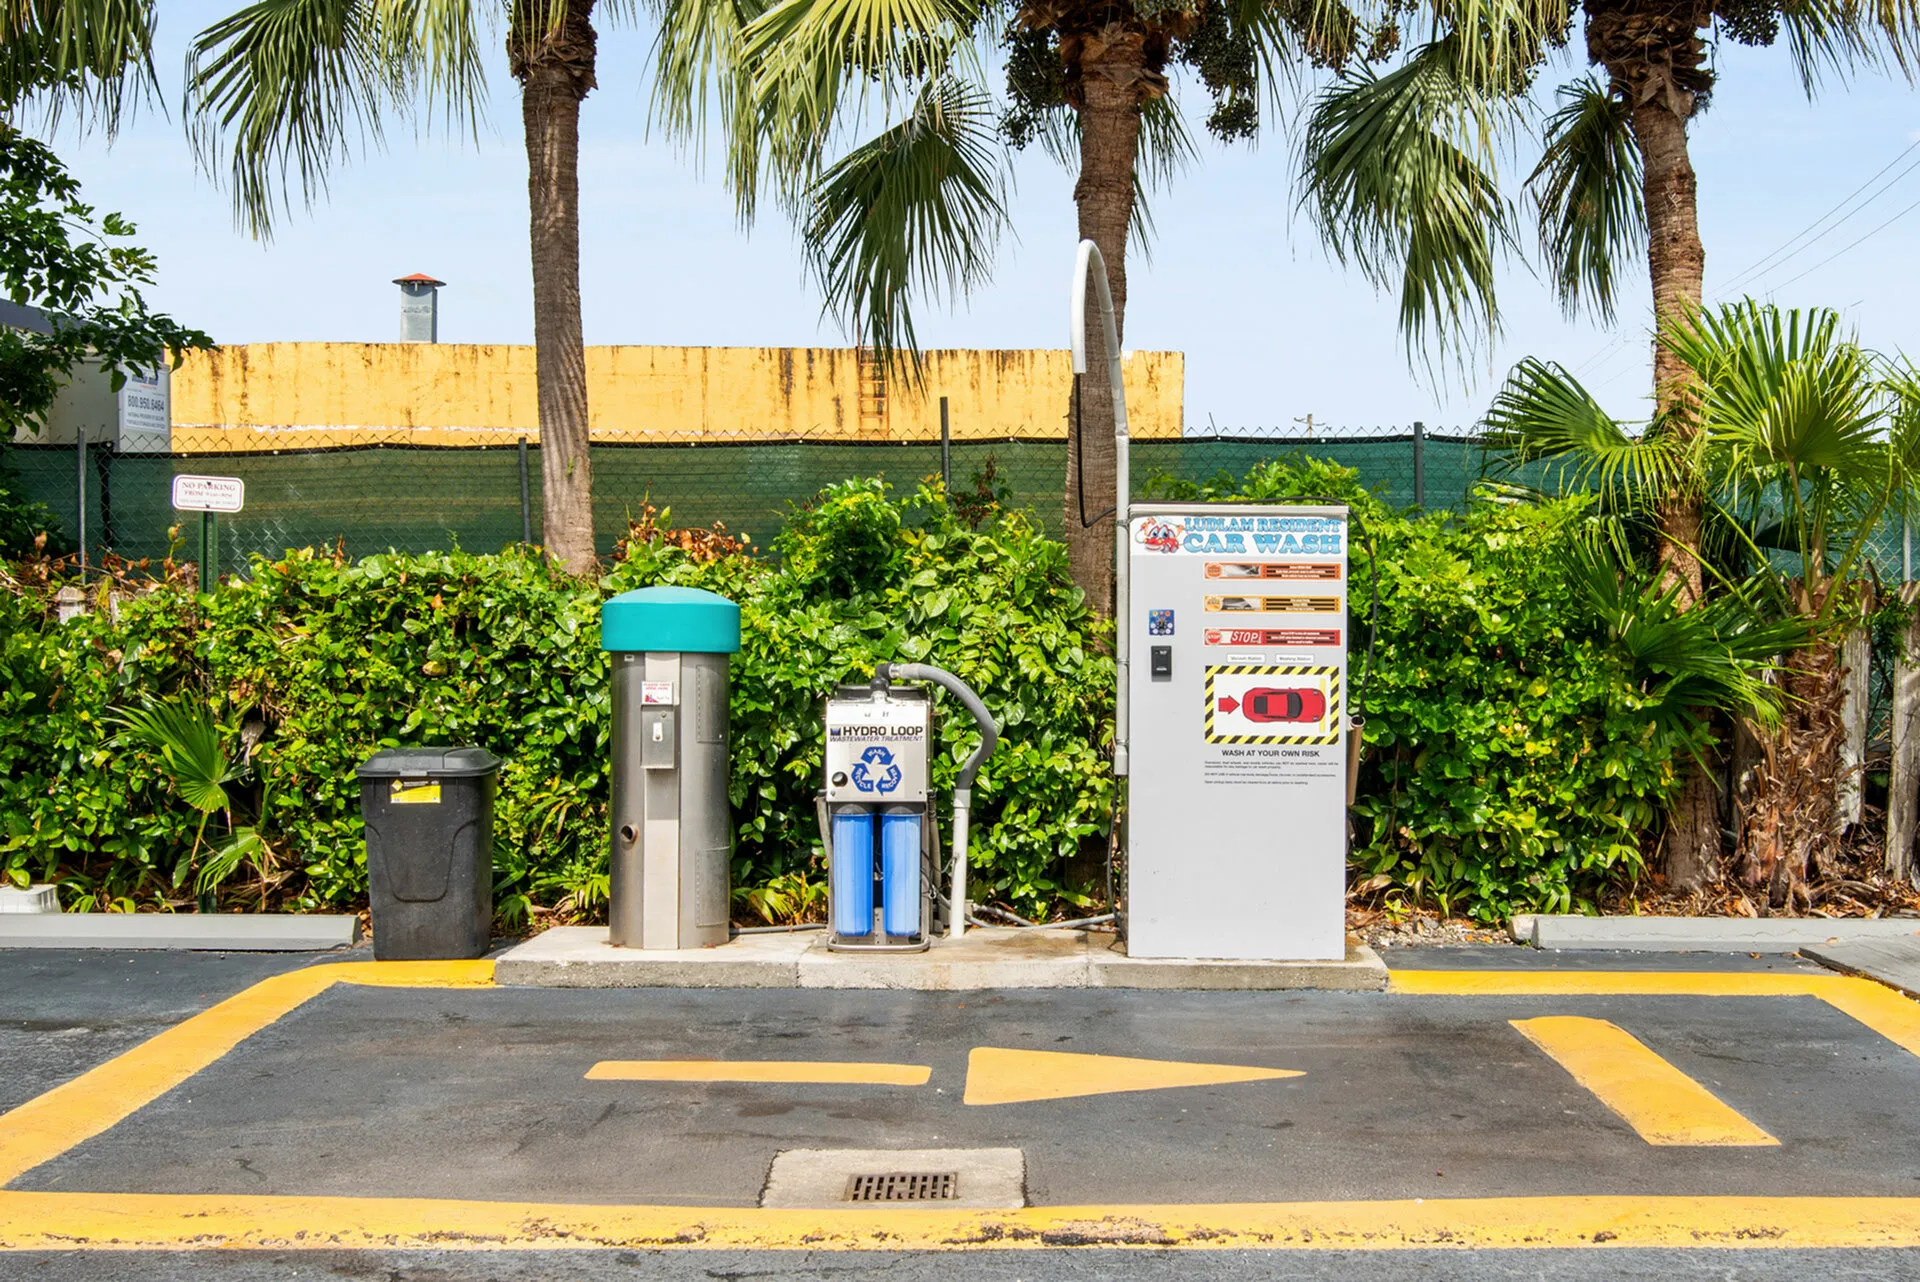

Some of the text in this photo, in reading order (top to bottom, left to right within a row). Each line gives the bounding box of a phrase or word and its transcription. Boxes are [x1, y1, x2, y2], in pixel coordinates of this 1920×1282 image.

[197, 482, 236, 491] PARKING
[1184, 517, 1342, 533] LUDLAM RESIDENT
[1183, 533, 1342, 554] CAR WASH
[843, 726, 923, 736] HYDRO LOOP
[867, 749, 886, 757] WASH
[1221, 749, 1245, 757] WASH
[855, 767, 871, 789] RECYCLE
